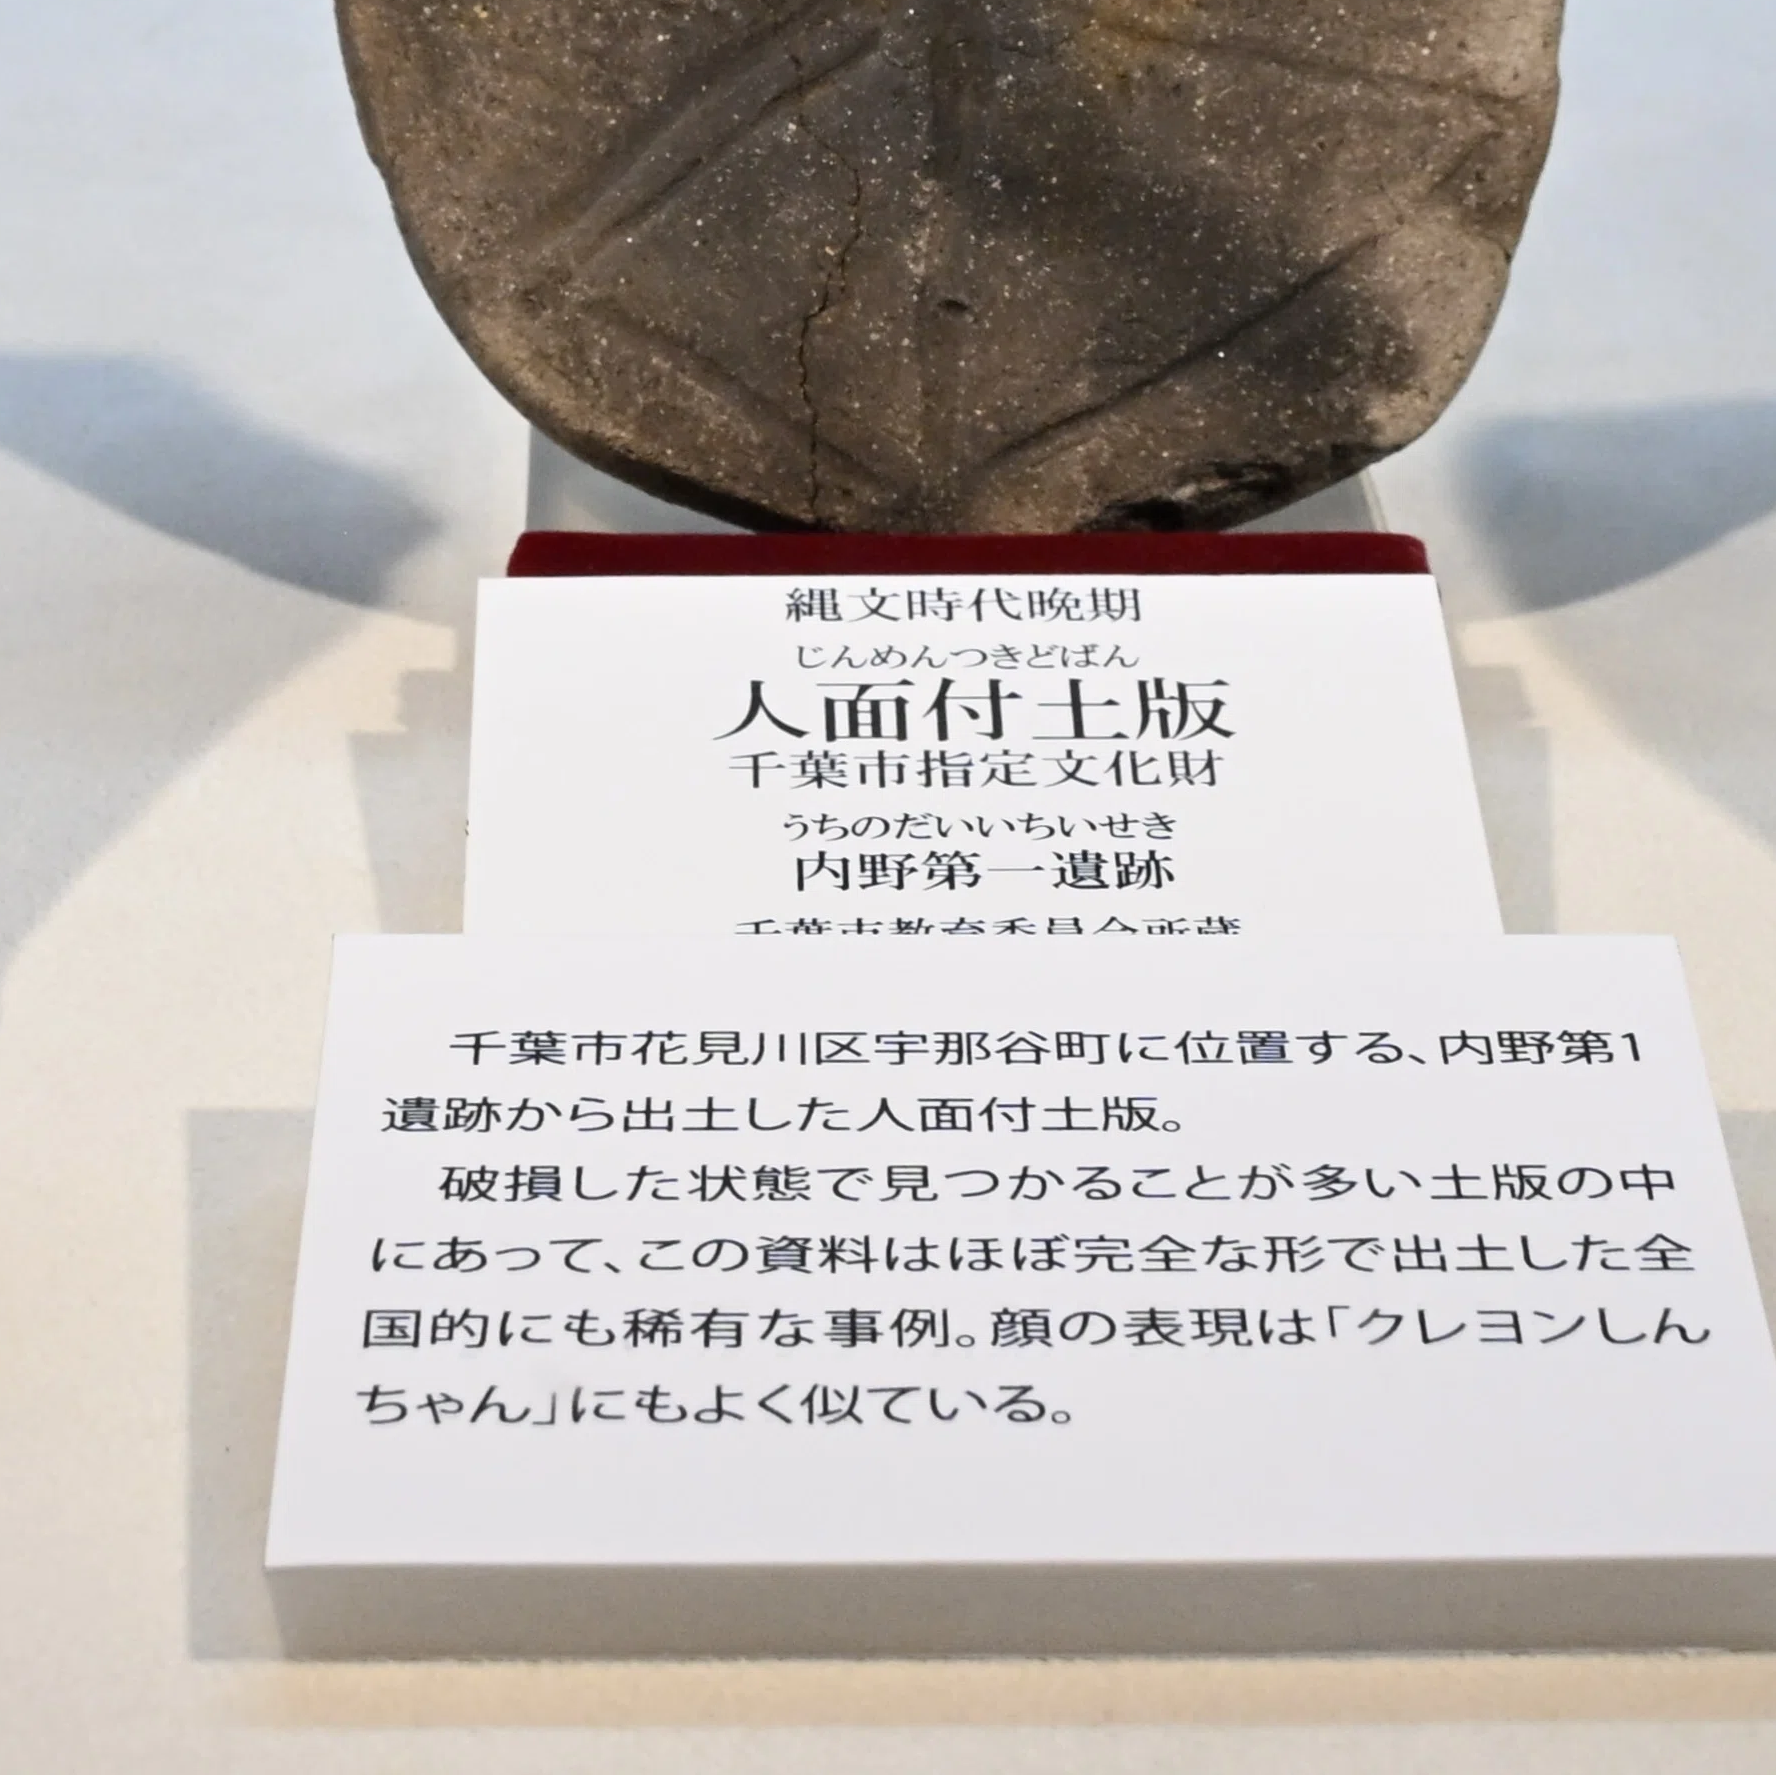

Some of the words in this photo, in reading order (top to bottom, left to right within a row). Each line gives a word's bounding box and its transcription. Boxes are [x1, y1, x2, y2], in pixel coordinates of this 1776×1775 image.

[785, 586, 1142, 623] 縄文時代晩期
[795, 643, 1140, 670] じんめんつきどばん
[712, 676, 1237, 743] 人面付土版
[728, 748, 1224, 790] 千葉市指定文化財
[782, 811, 1178, 842] うちのだいいちいせき
[795, 848, 1176, 893] 内野第一遺跡
[448, 1028, 1642, 1068] 千葉市花見川区宇那谷町に位置する、内野第1
[379, 1095, 1183, 1134] 遺跡から出土した人面付土版。
[436, 1162, 1676, 1204] 破損した状態で見つかることが多い土版の中
[370, 1232, 1697, 1276] にあって、この資料はほぼ完全な形で出土した全
[361, 1304, 1712, 1351] 国的にも稀有な事例。顔の表現は「クレヨンしん
[355, 1382, 1073, 1427] ちゃん」にもよく似ている。
